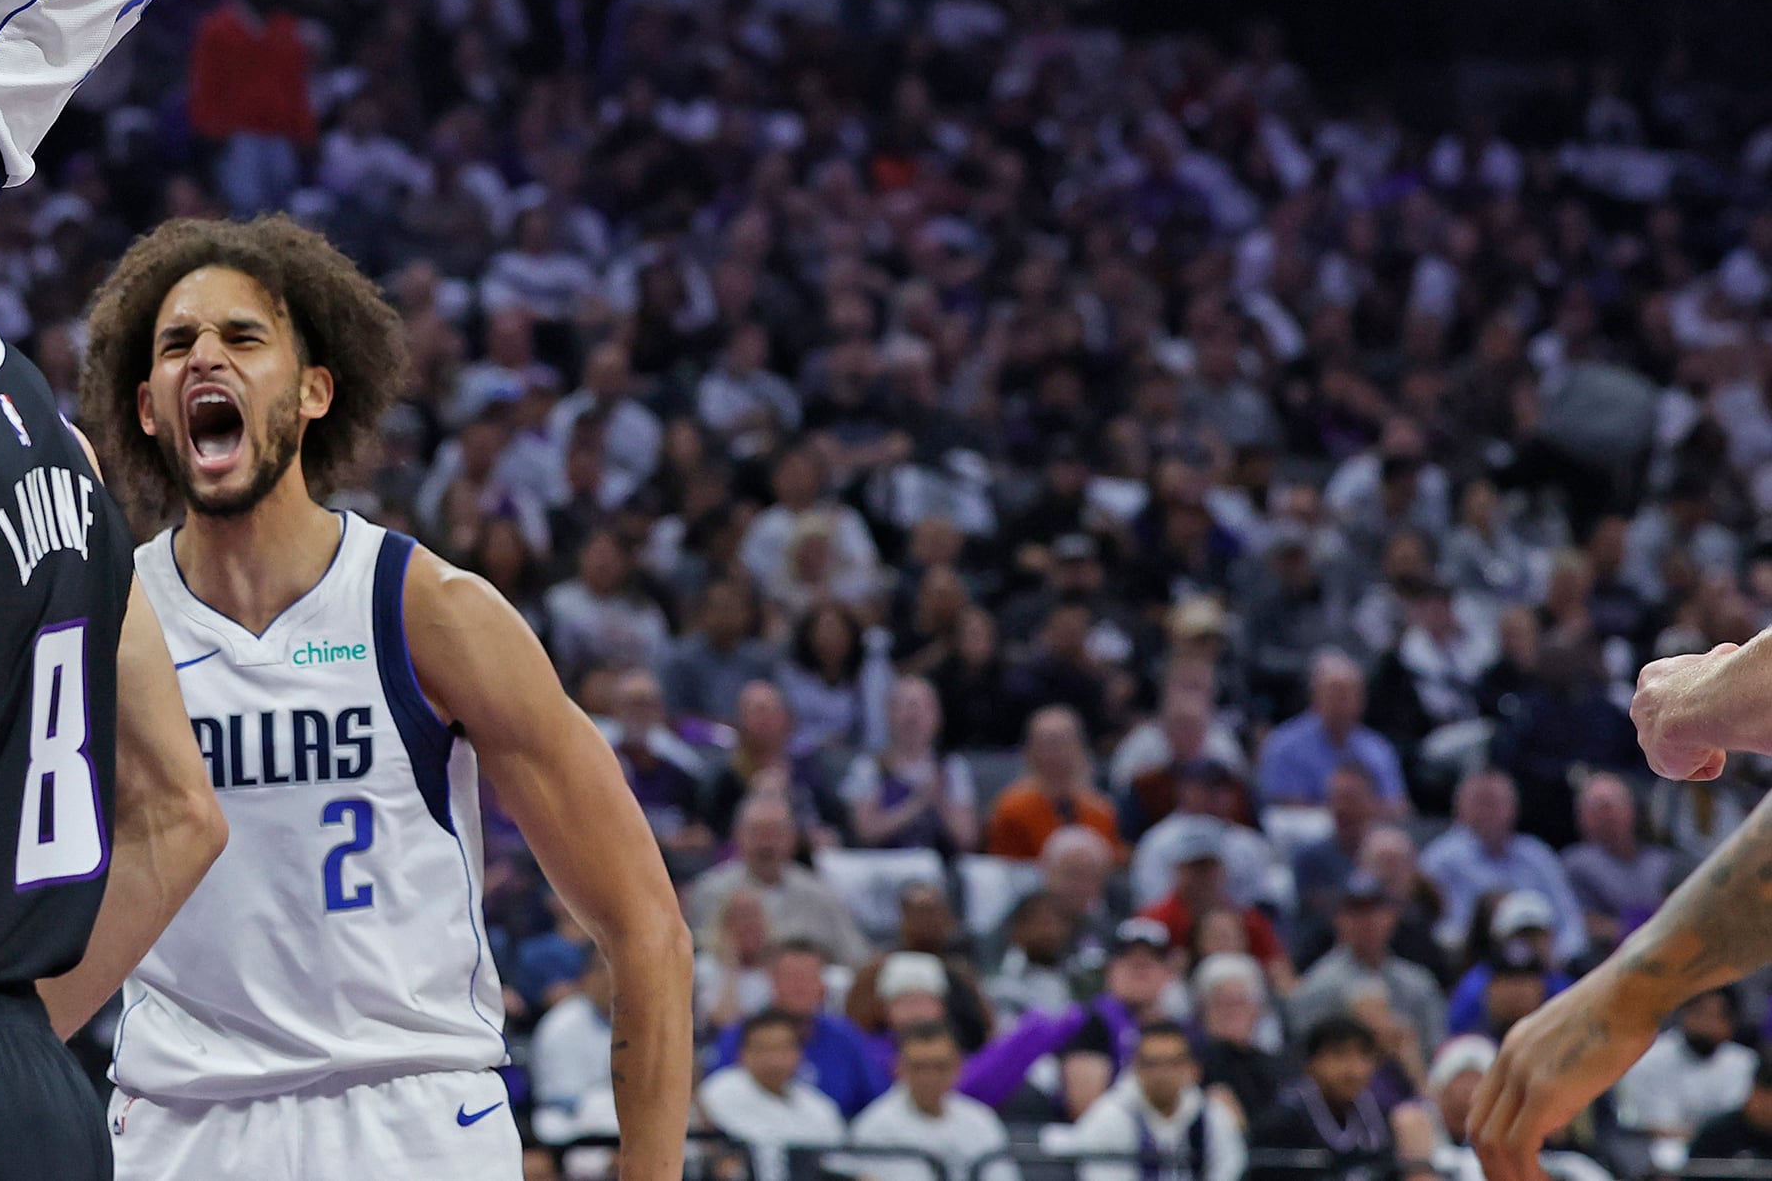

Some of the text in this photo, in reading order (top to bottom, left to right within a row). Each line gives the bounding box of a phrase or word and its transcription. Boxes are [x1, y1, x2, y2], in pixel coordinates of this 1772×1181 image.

[292, 640, 367, 666] chime
[14, 619, 109, 892] 8
[190, 705, 374, 789] ALLAS
[320, 797, 375, 914] 2
